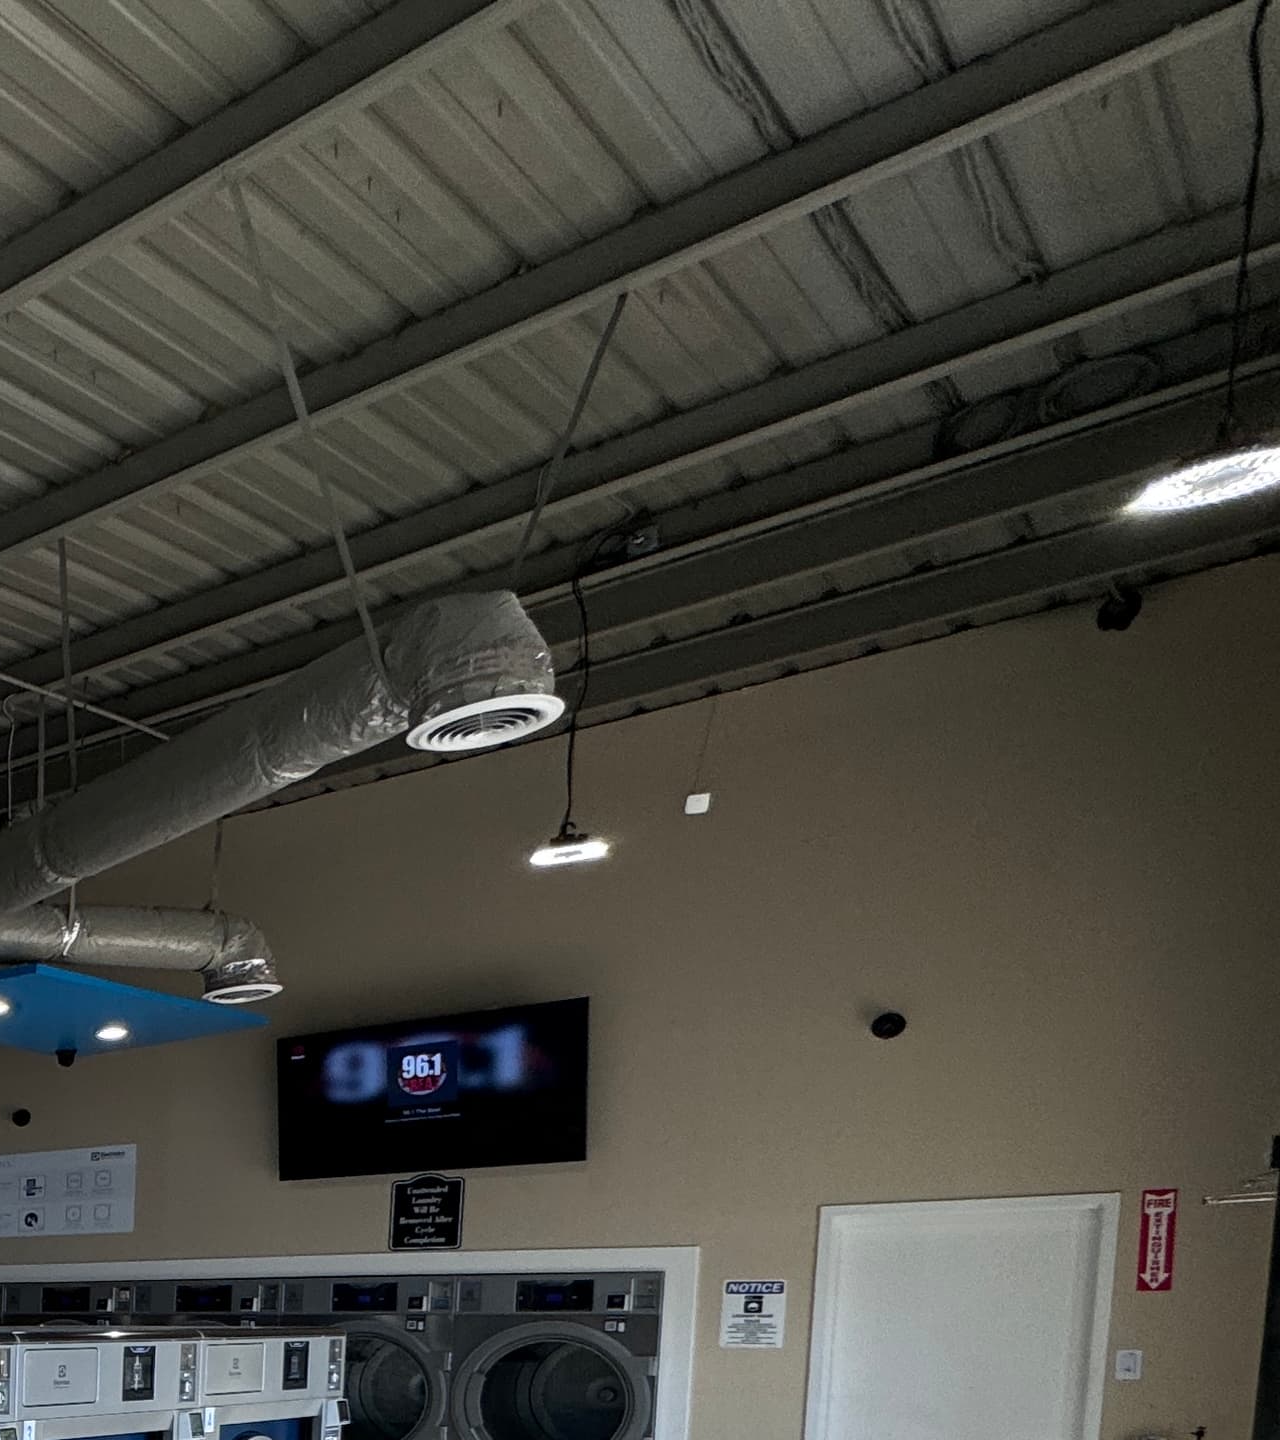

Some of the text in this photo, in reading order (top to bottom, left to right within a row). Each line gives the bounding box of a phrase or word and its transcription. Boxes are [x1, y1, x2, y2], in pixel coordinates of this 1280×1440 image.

[402, 1053, 442, 1079] 96.1
[412, 1196, 442, 1204] Laundry
[1146, 1198, 1172, 1208] FIRE
[399, 1215, 453, 1224] Removed After
[1150, 1211, 1163, 1283] EXTINGUISHER
[727, 1283, 783, 1292] NOTICE
